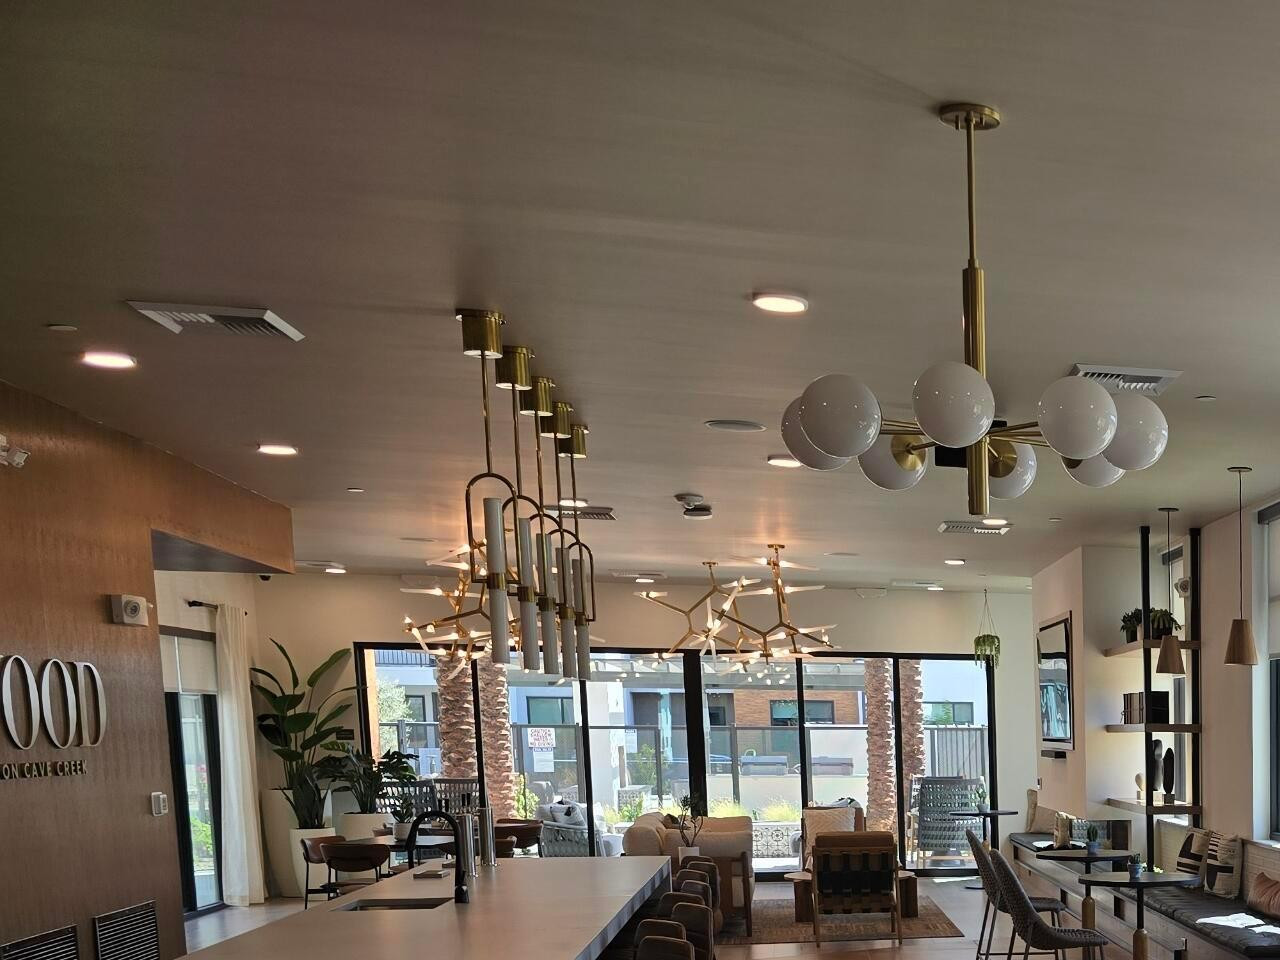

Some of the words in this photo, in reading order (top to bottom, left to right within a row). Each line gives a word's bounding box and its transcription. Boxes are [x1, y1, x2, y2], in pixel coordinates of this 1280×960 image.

[0, 655, 107, 750] OOD
[2, 763, 19, 780] ON
[24, 761, 53, 778] CAVE
[57, 759, 88, 777] CREEK
